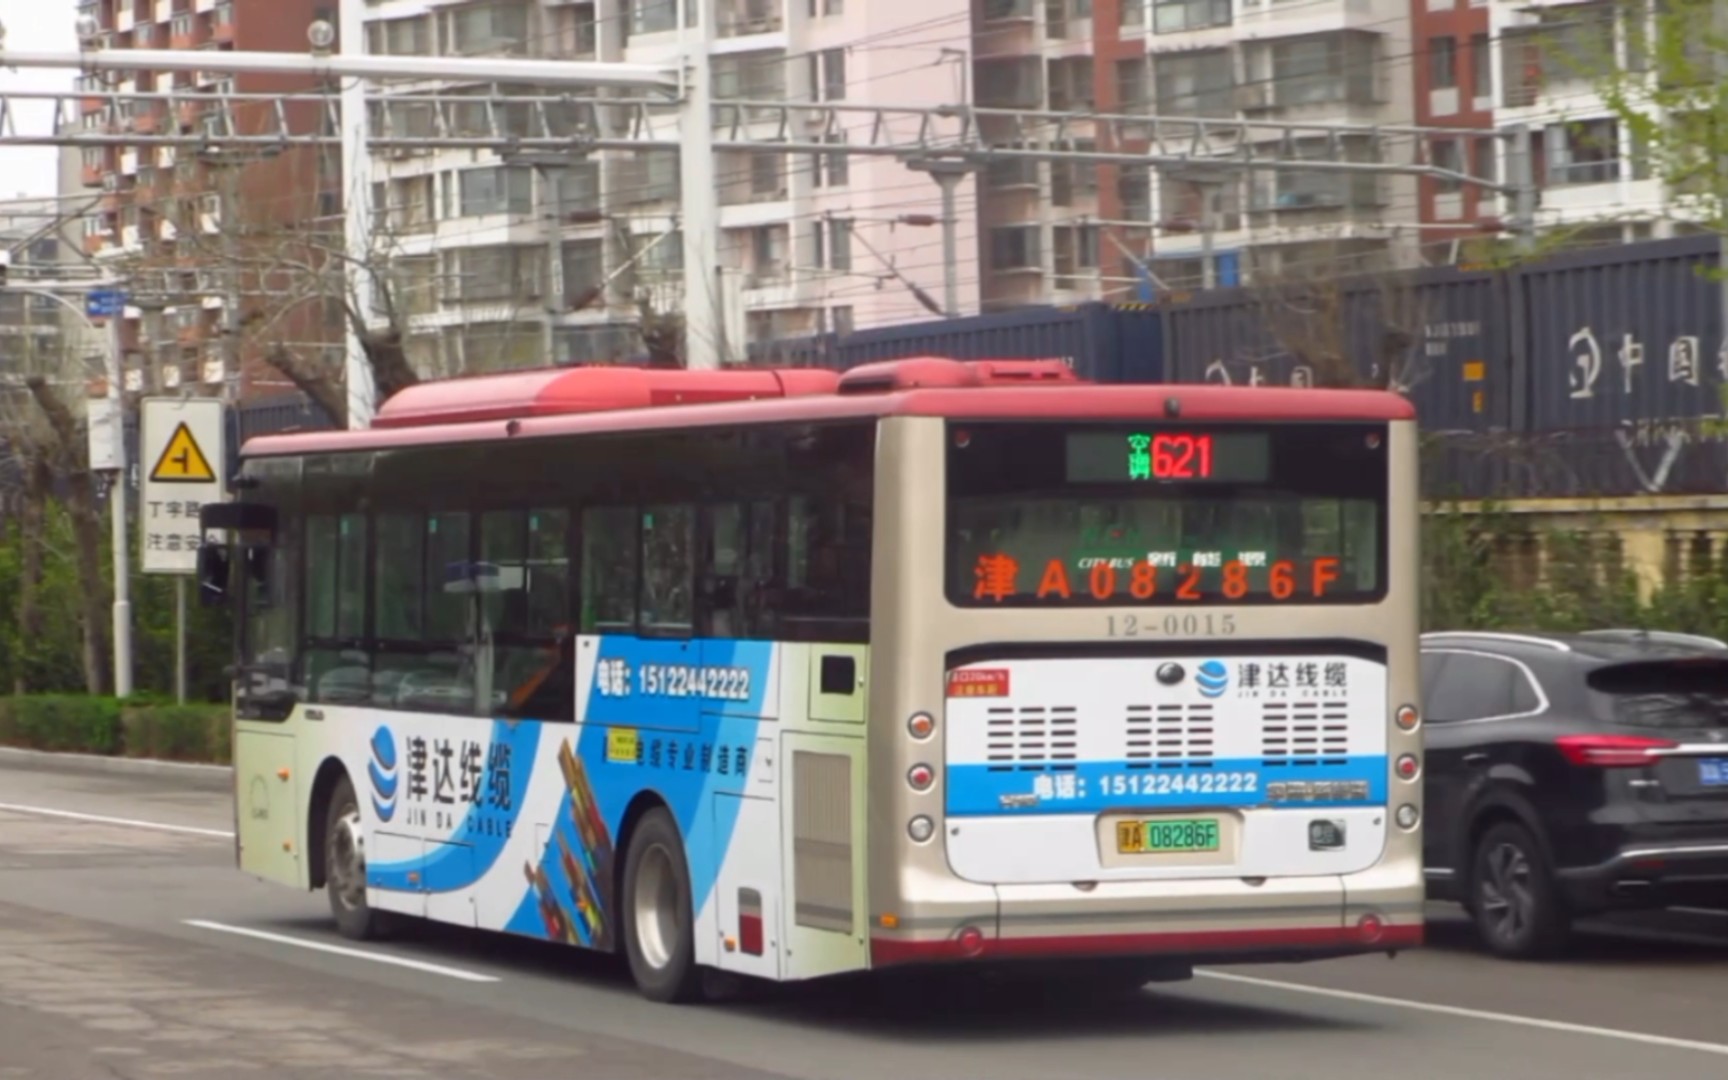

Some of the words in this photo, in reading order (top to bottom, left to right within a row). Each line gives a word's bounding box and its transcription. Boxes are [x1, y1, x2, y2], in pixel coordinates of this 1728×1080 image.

[1152, 435, 1212, 478] 621
[147, 501, 200, 518] 丁字路
[1106, 613, 1237, 637] 12-0015
[639, 664, 750, 700] 15122442222
[1238, 661, 1348, 688] 津达线缆
[405, 735, 512, 812] 津达线缆
[1033, 773, 1086, 800] 电话：
[1099, 772, 1258, 796] 15122442222
[406, 807, 427, 827] JIN
[435, 811, 453, 830] DA
[465, 815, 512, 839] CABLE
